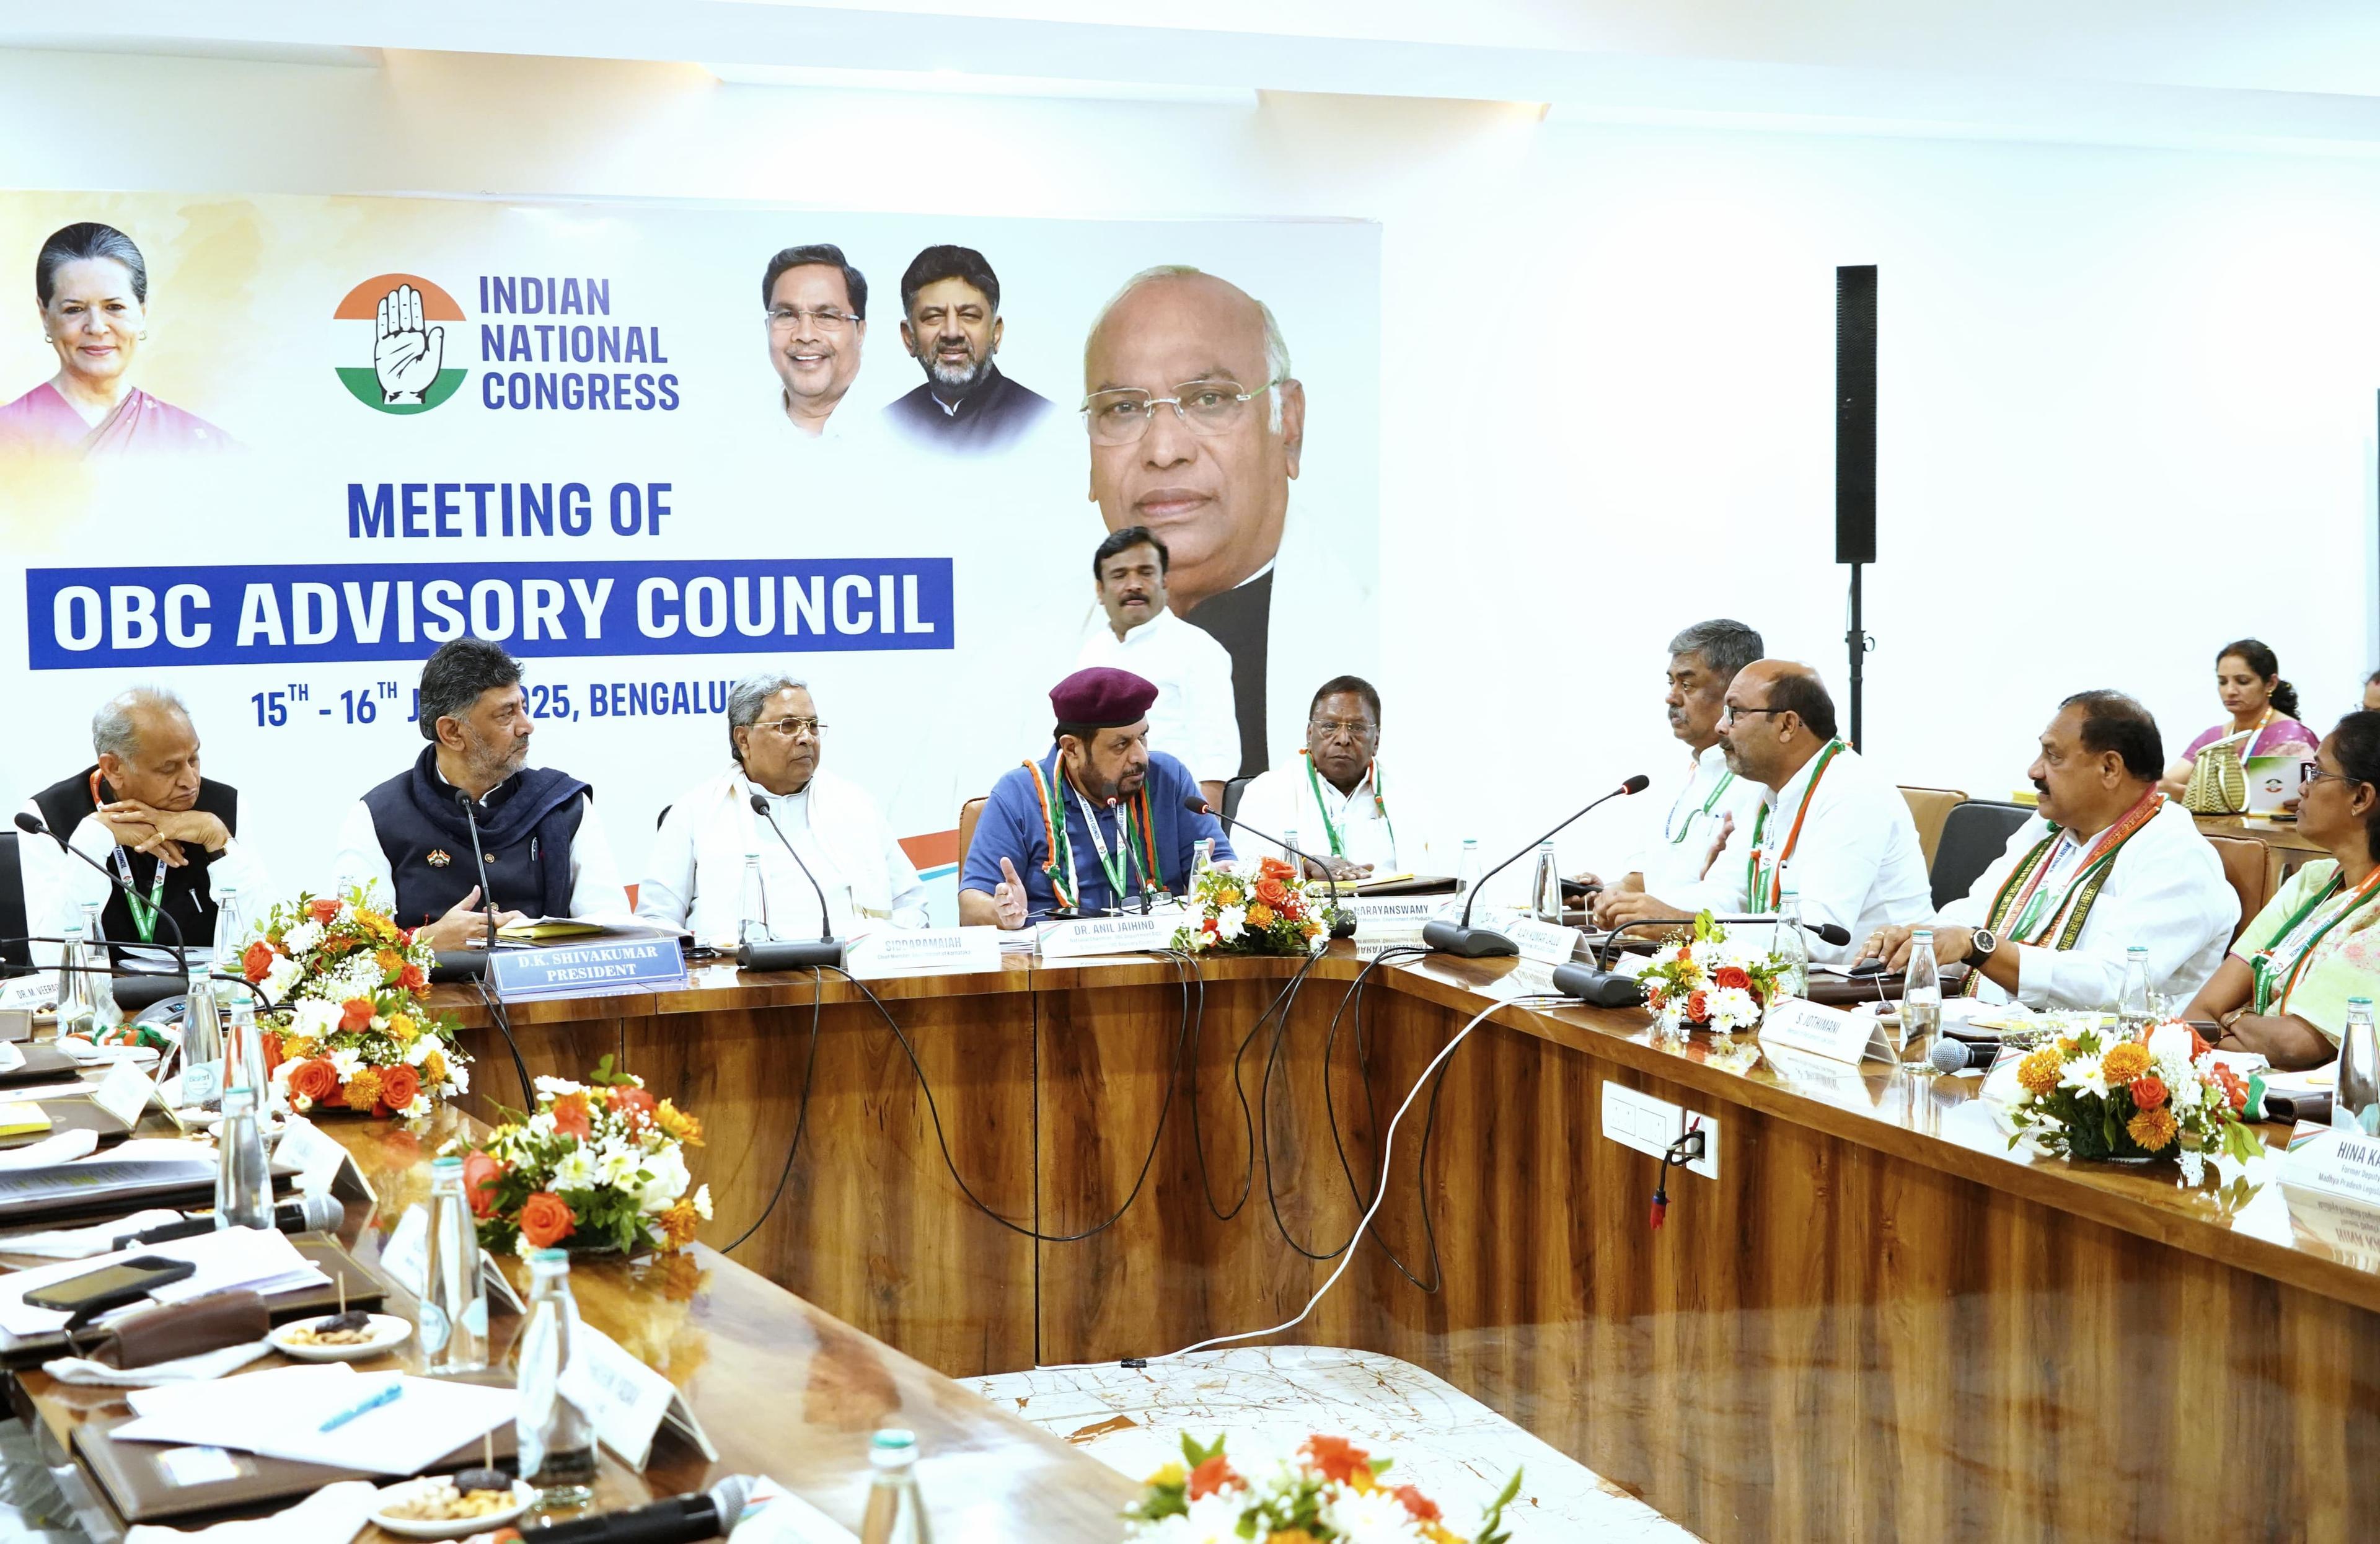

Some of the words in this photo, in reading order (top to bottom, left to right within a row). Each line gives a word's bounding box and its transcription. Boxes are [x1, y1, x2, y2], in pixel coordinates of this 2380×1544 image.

[480, 276, 610, 315] INDIAN
[481, 324, 668, 364] NATIONAL
[482, 371, 680, 411] CONGRESS
[347, 482, 593, 539] MEETING
[609, 482, 672, 537] OF
[53, 583, 212, 651] OBC
[236, 578, 615, 647] ADVISORY
[636, 574, 935, 639] COUNCIL
[519, 684, 580, 723] 25,
[589, 680, 736, 718] BENGALU
[1073, 925, 1091, 936] DR.
[1093, 922, 1115, 934] ANIL
[1117, 920, 1155, 932] JAIHIND
[518, 955, 549, 968] D.K.
[552, 945, 658, 965] SHIVAKUMAR
[2289, 939, 2309, 958] COUNCIL
[546, 963, 637, 982] PRESIDENT
[15, 990, 29, 999] DR.
[1802, 1013, 1841, 1034] JOTHIMANI
[2337, 1140, 2366, 1164] HINA
[2318, 1172, 2339, 1185] Madhya
[2340, 1178, 2362, 1190] Pradesh
[2341, 1164, 2361, 1176] Former
